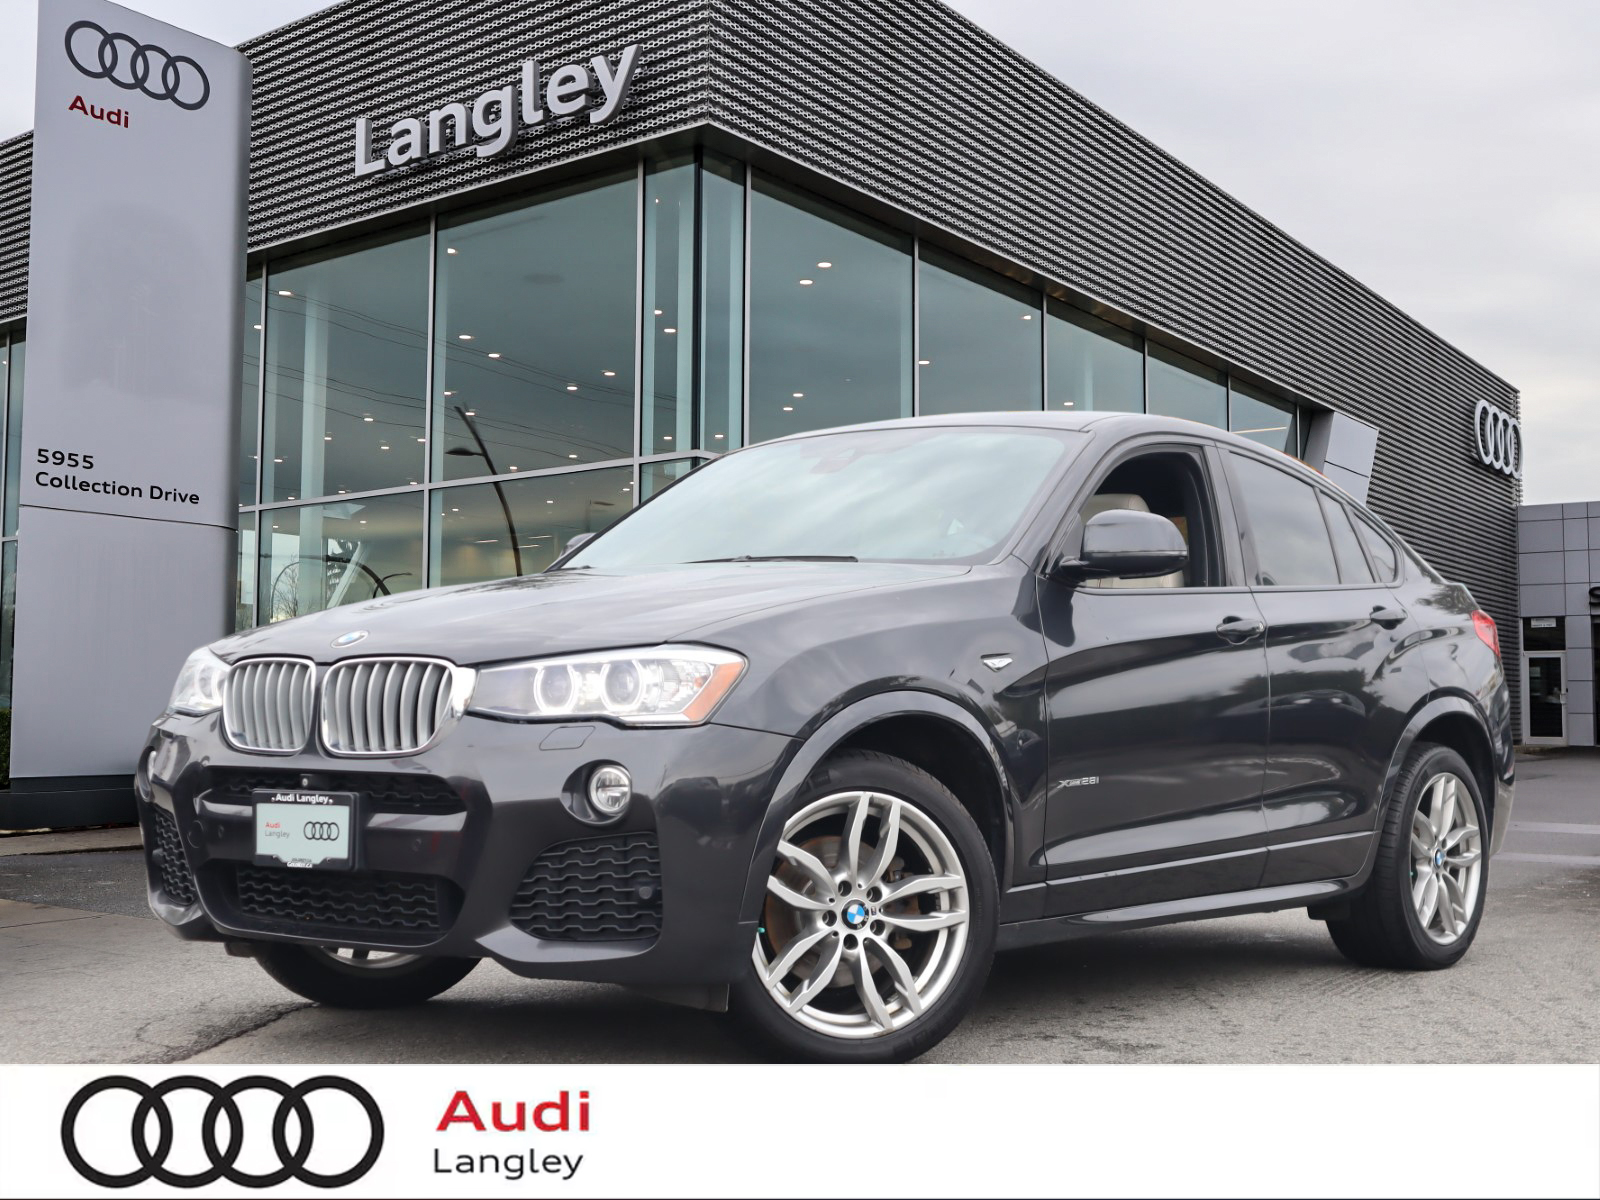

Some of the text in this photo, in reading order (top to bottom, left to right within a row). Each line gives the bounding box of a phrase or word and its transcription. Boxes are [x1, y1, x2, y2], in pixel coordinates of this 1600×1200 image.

[69, 95, 129, 129] Audi
[355, 44, 643, 177] Langley
[37, 448, 94, 469] 5955
[35, 471, 200, 505] Collection Drive
[275, 793, 329, 804] Audi Langley
[265, 830, 290, 839] Langley
